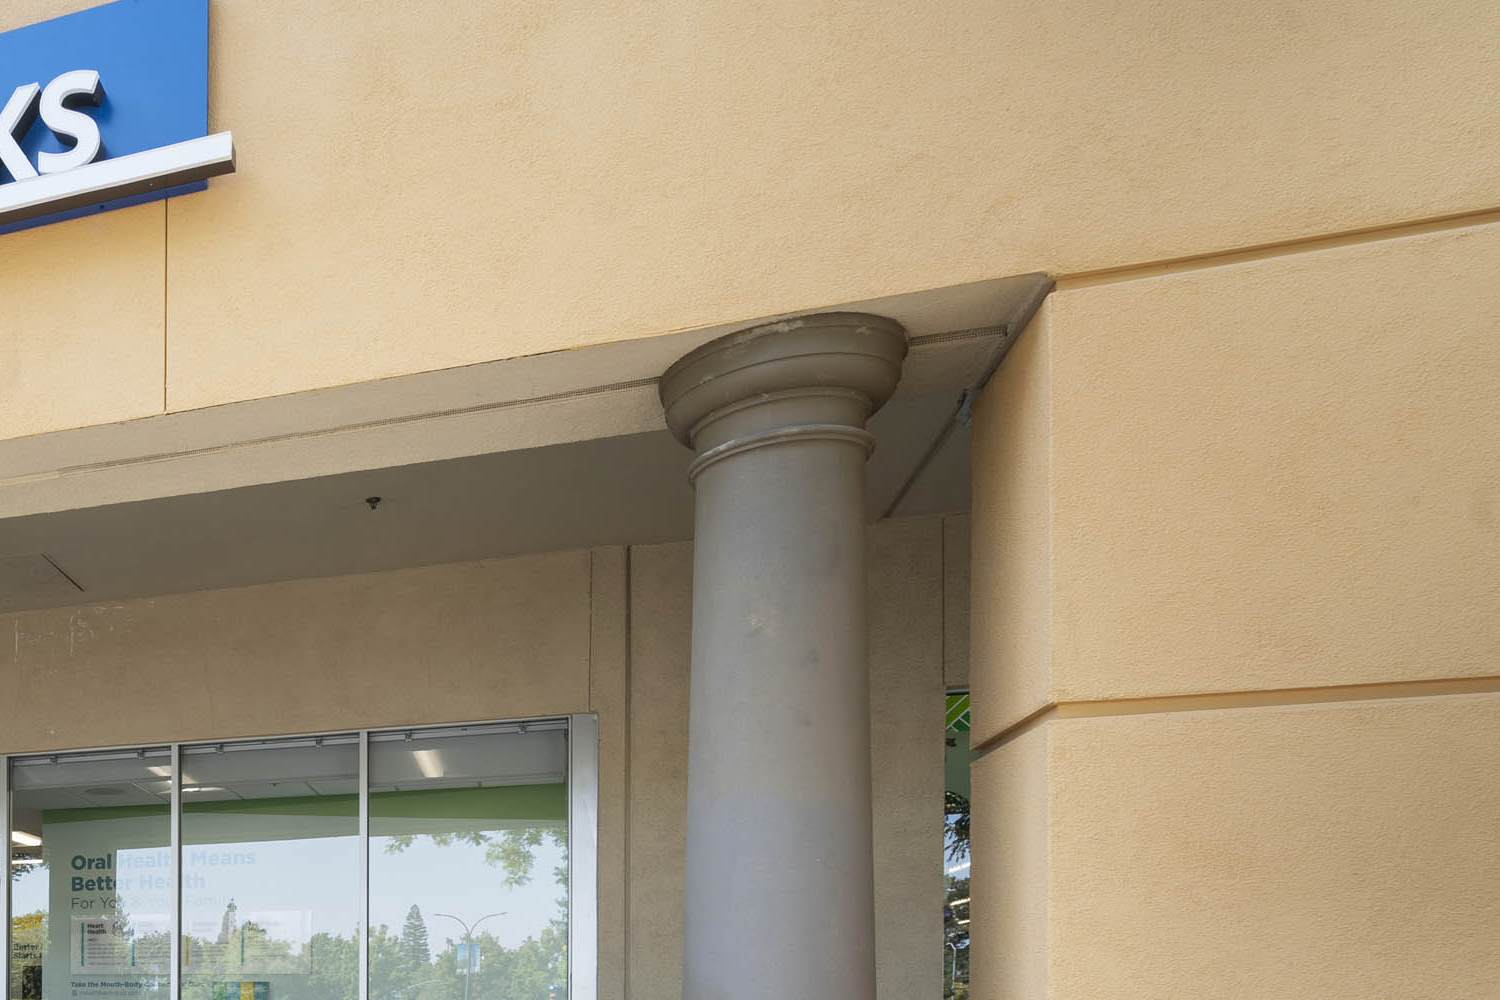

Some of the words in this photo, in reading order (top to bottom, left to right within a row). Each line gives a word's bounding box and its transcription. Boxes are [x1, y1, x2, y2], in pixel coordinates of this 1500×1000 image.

[71, 853, 112, 870] Oral
[120, 851, 172, 869] Healt
[191, 850, 257, 866] Means
[71, 876, 132, 891] Better
[140, 873, 205, 889] Heath
[71, 897, 95, 909] For
[147, 896, 173, 907] You
